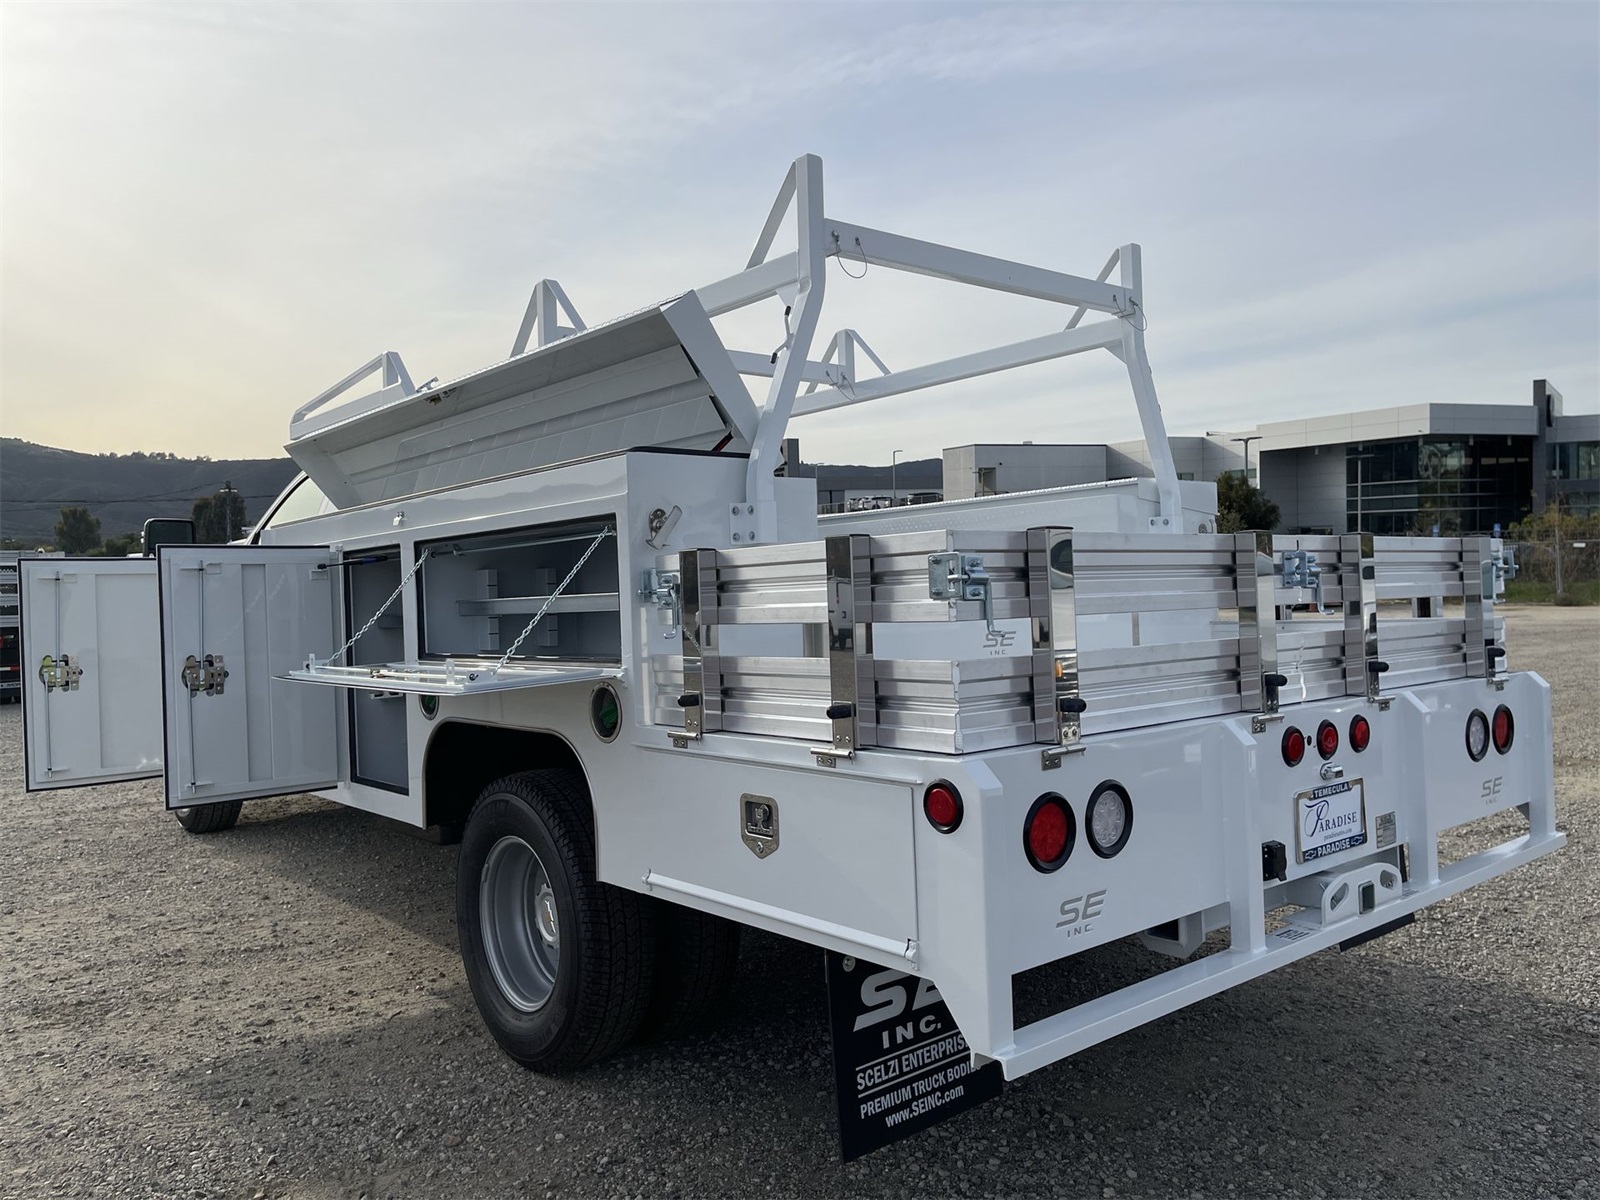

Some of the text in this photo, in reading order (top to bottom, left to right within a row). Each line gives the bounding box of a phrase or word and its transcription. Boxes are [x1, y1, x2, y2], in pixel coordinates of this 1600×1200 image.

[983, 630, 1016, 648] SE
[1314, 782, 1349, 798] TEMECULA
[1481, 776, 1503, 798] SE
[1304, 800, 1358, 838] PARADISE
[1317, 838, 1351, 857] PARADISE
[1056, 889, 1107, 928] SE
[882, 1015, 941, 1049] INC.
[856, 1034, 970, 1090] SCELZI ENTERPRIS
[860, 1085, 912, 1120] PREMIUM
[912, 1071, 947, 1098] TRUCK
[885, 1085, 965, 1128] www.SEINC.com
